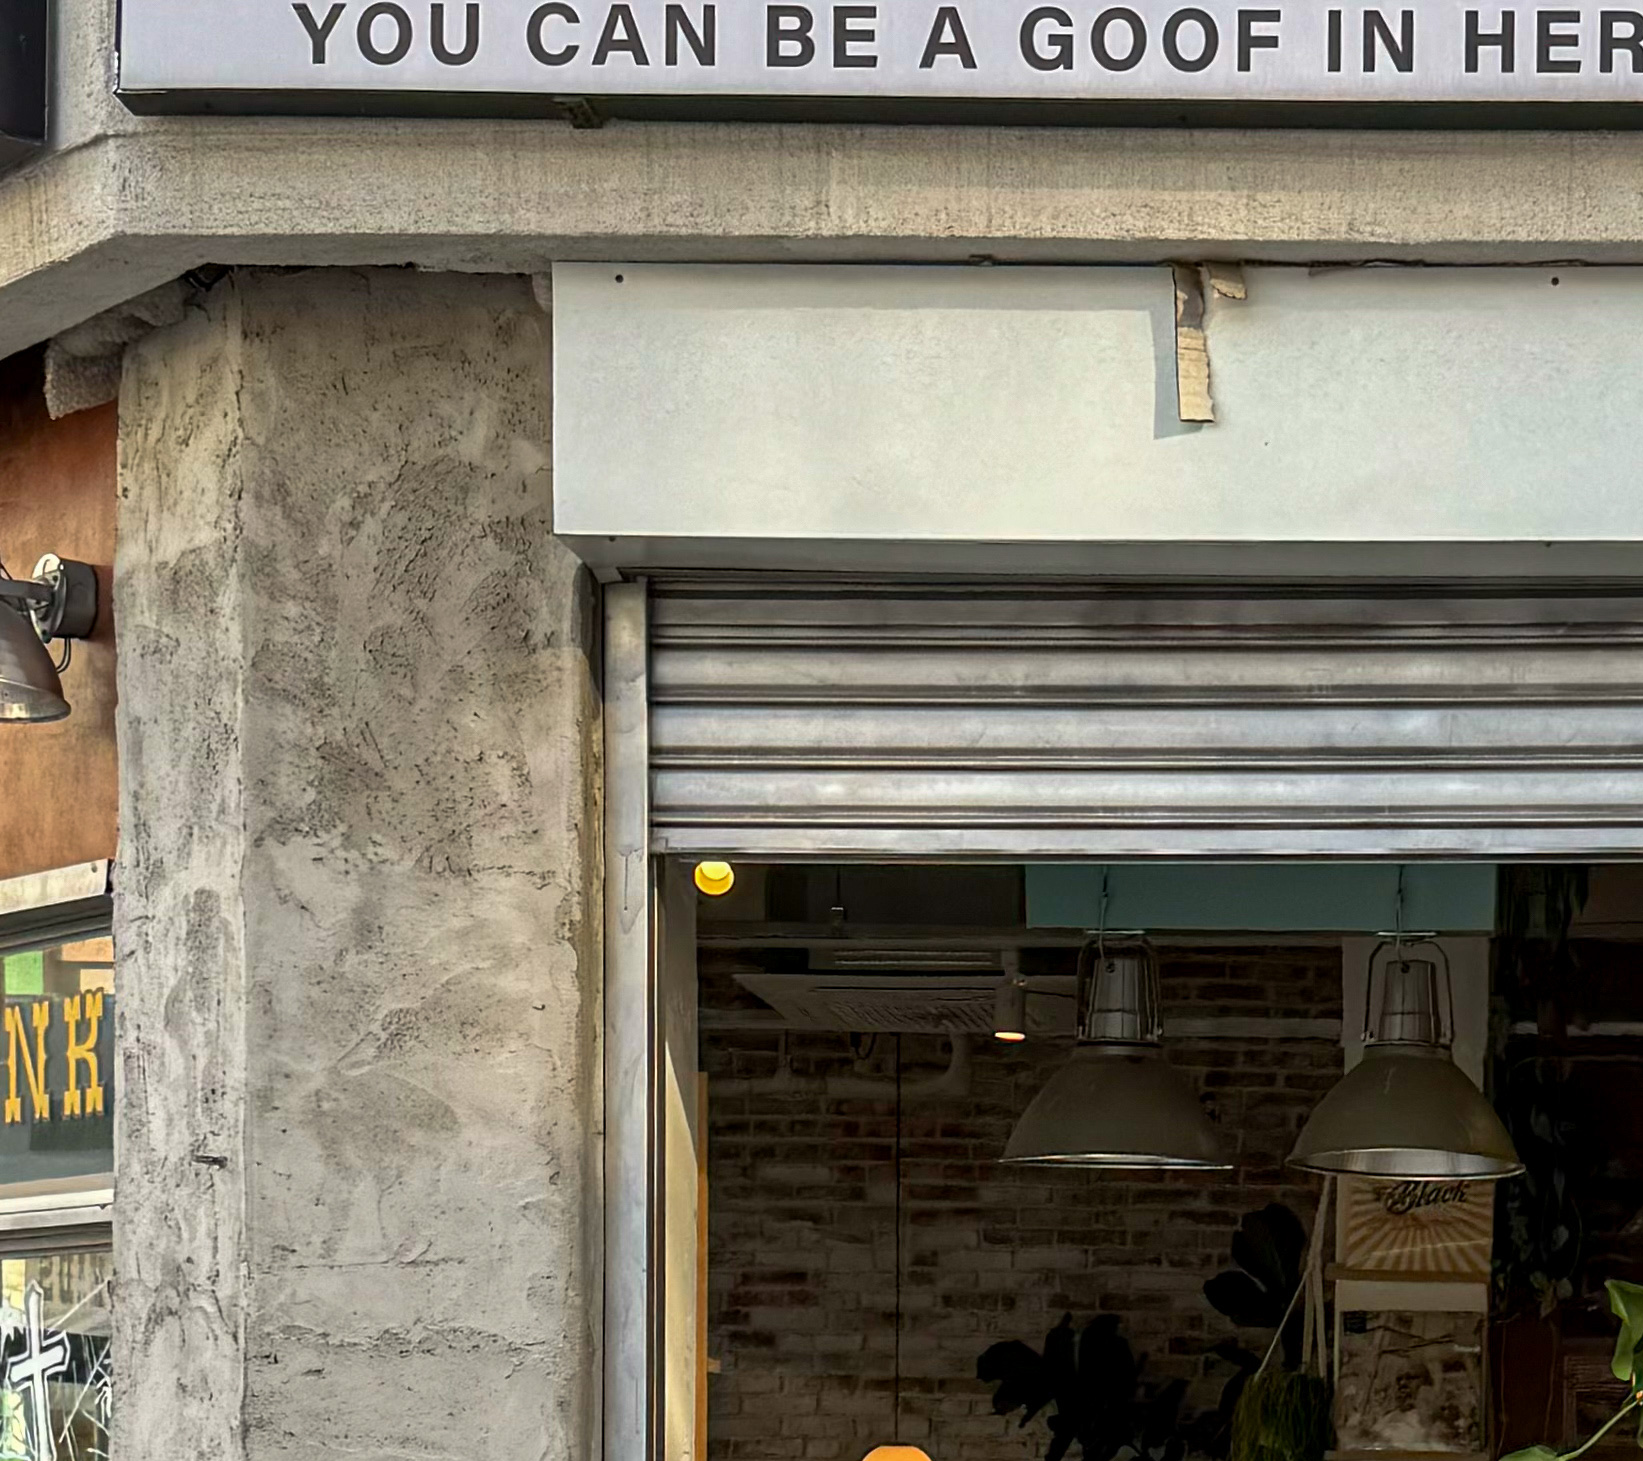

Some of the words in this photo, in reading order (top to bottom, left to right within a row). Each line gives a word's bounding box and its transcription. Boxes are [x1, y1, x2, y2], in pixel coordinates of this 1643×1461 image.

[292, 2, 479, 65] YOU
[527, 3, 715, 66] CAN
[767, 5, 877, 67] BE
[920, 7, 977, 68] A
[1020, 7, 1280, 72] GOOF
[1328, 10, 1413, 72] IN
